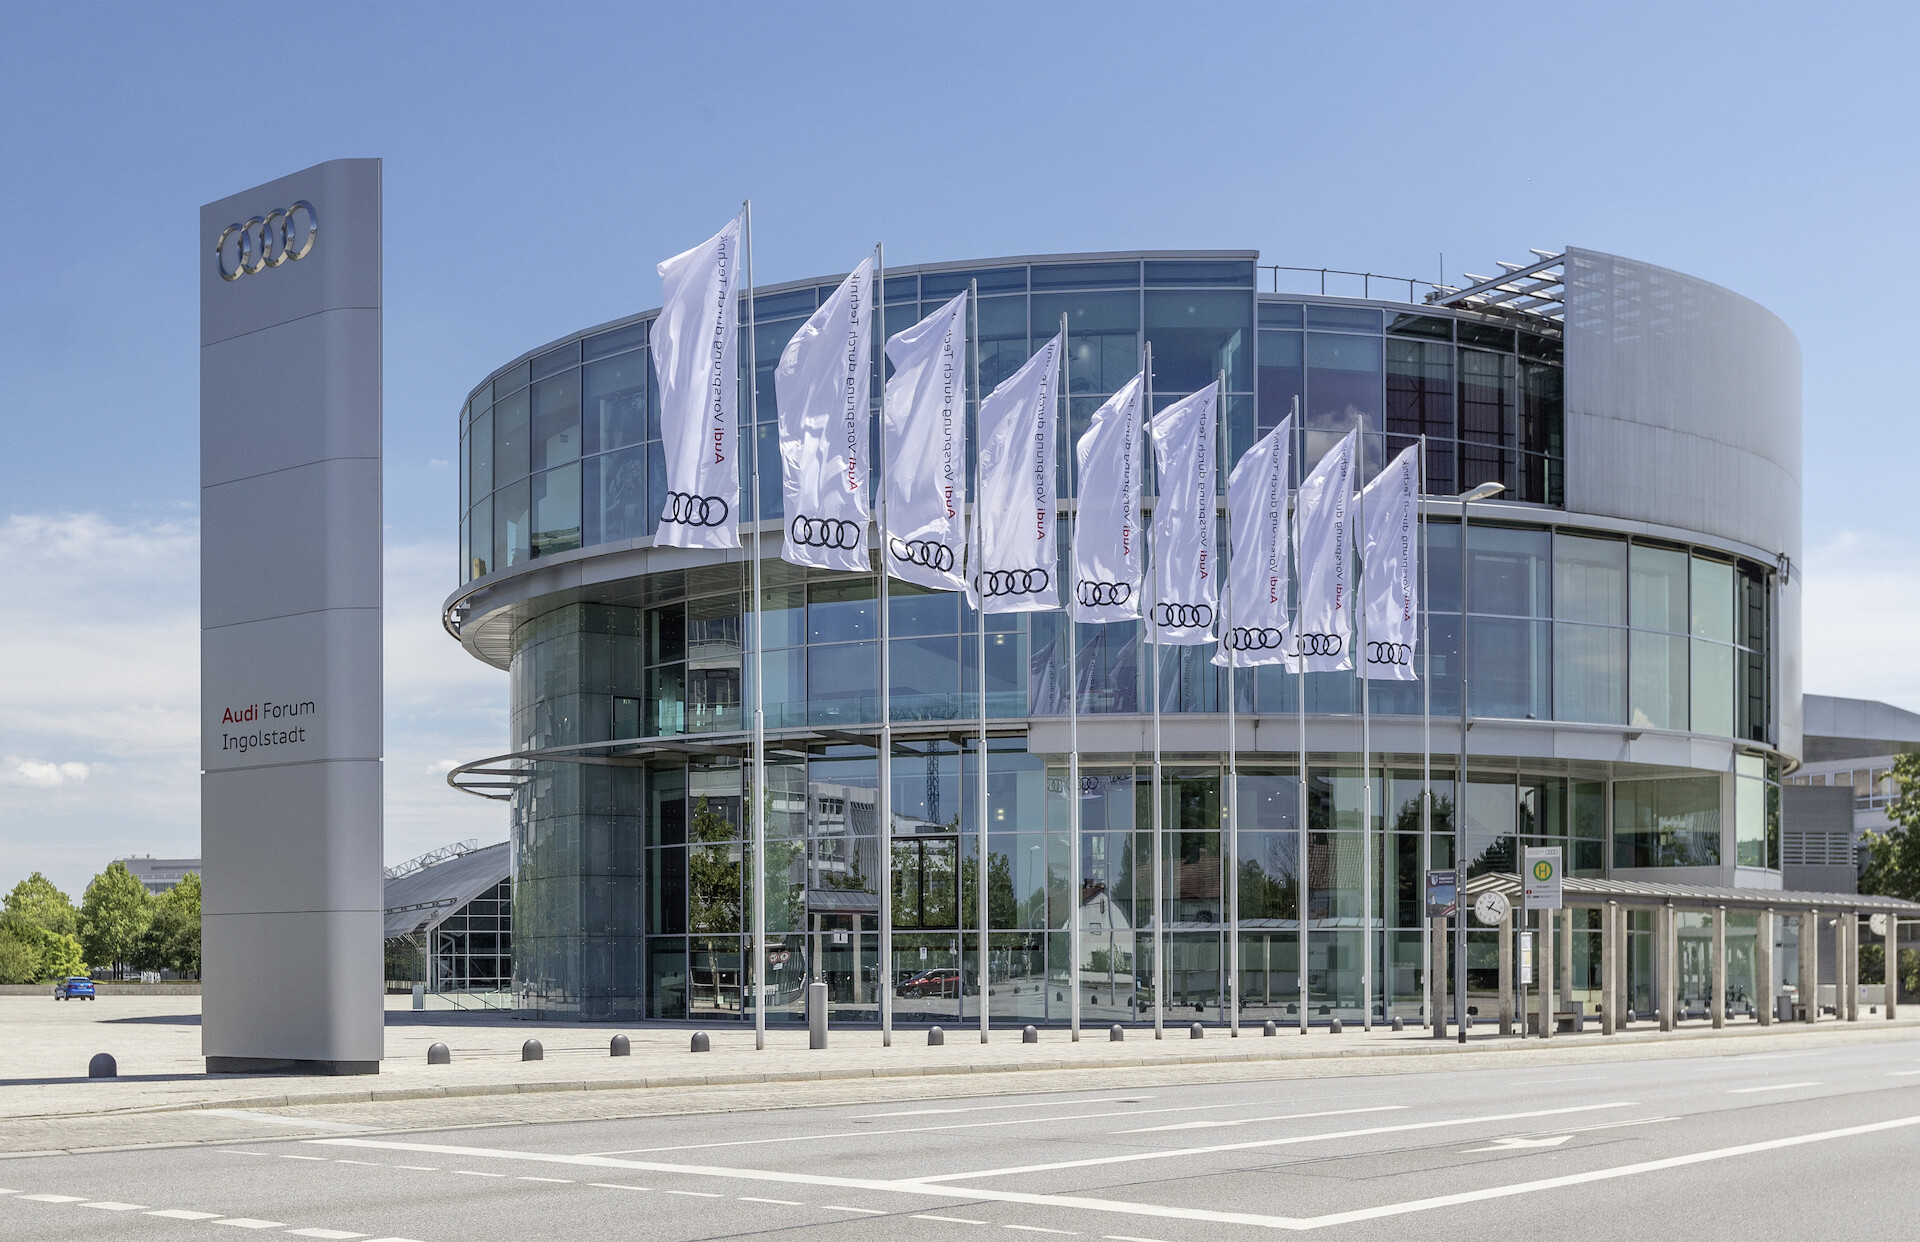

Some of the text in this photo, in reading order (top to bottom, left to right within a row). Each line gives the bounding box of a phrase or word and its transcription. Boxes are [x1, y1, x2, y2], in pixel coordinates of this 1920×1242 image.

[222, 701, 315, 724] Audi Forum
[222, 726, 306, 753] Ingolstadt
[1539, 865, 1547, 877] H
